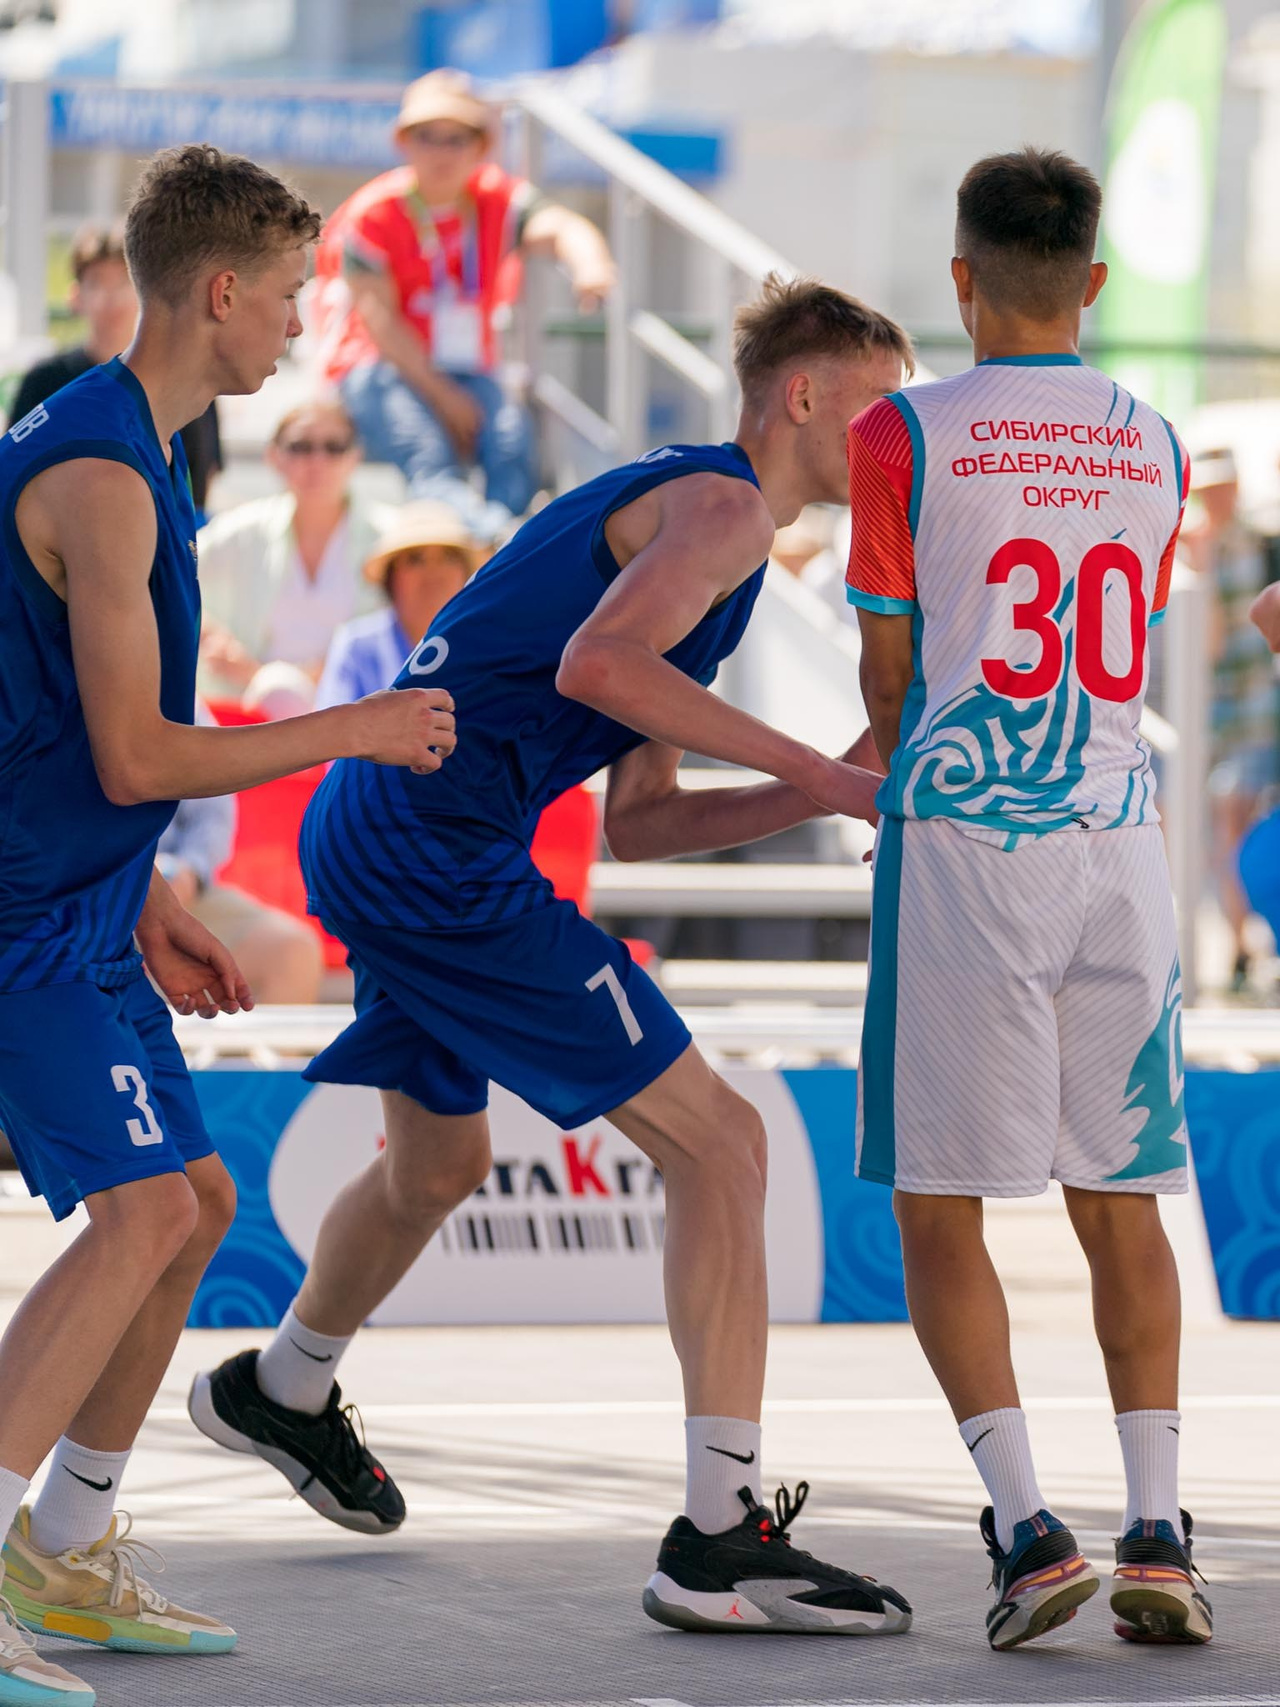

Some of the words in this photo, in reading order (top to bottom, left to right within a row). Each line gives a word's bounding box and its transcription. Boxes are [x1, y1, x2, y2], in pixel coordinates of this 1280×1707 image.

[970, 420, 1143, 450] СИБИРСКИЙ
[951, 452, 1163, 488] ФЕДЕРАЛЬНЫЙ
[1023, 485, 1111, 511] ОКРУГ
[980, 537, 1147, 704] 30
[584, 962, 644, 1047] 7
[110, 1064, 164, 1147] 3
